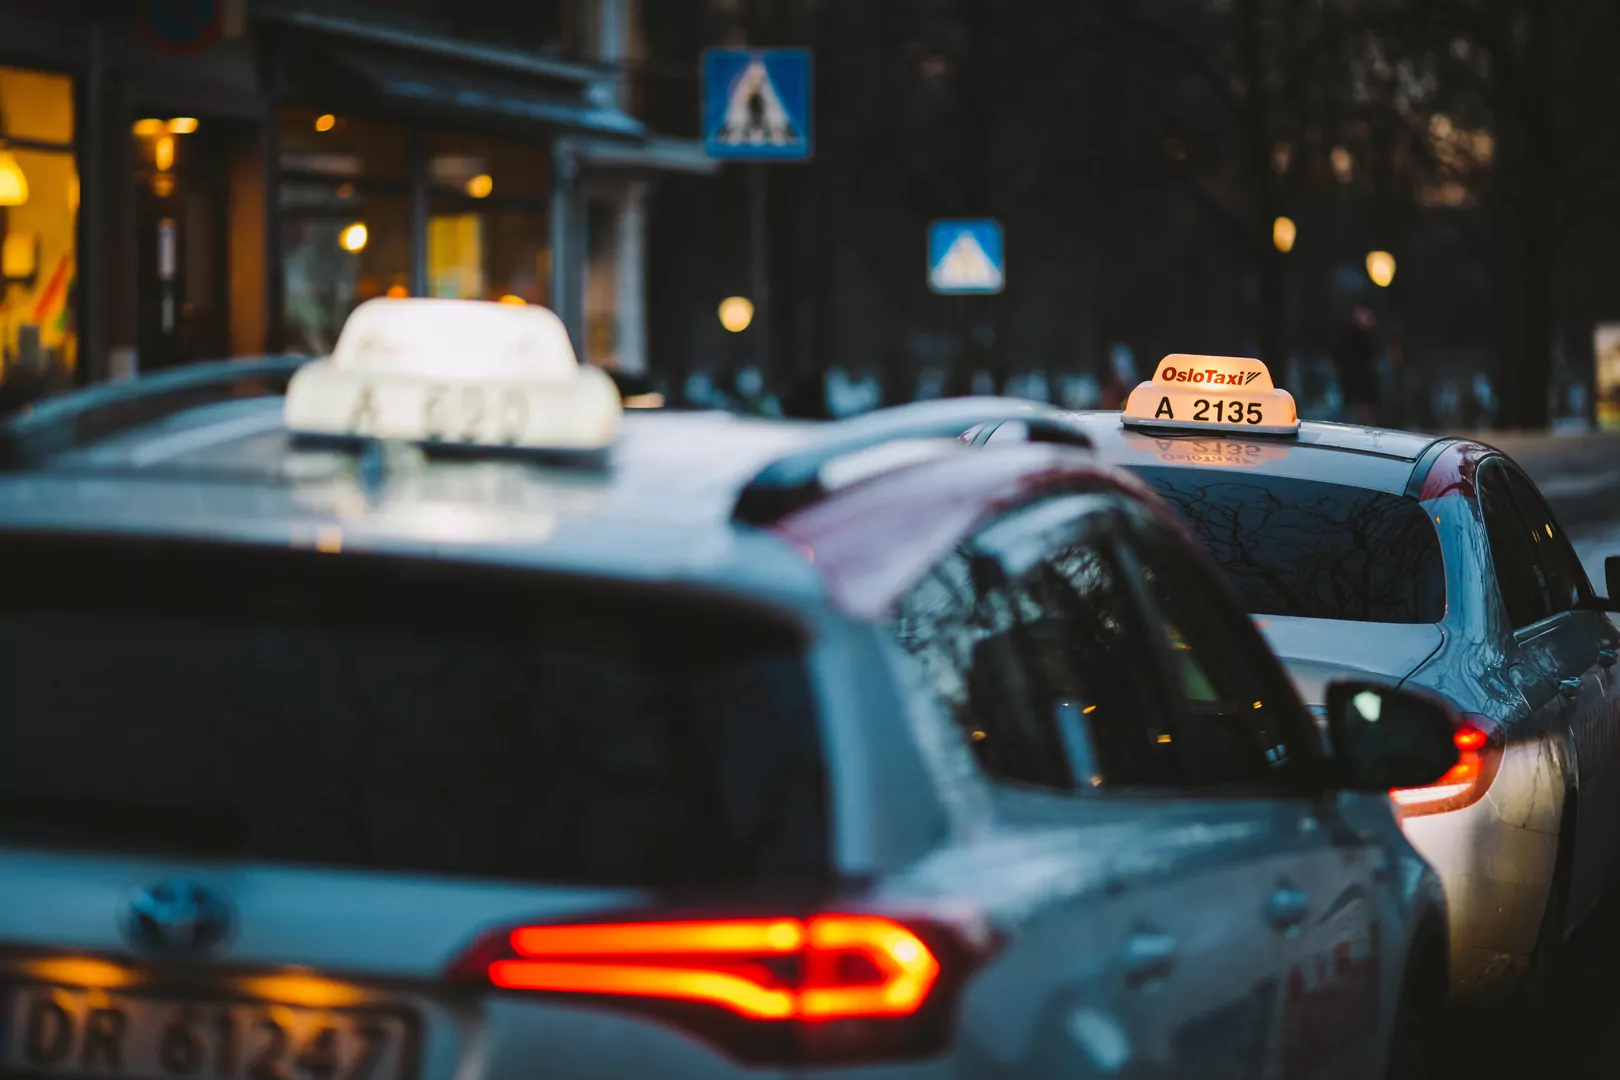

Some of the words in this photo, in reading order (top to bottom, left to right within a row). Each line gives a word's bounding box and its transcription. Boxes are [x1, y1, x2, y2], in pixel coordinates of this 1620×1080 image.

[1161, 367, 1245, 386] OsloTaxi
[1154, 396, 1174, 419] A
[1193, 399, 1263, 425] 2135
[25, 996, 128, 1072] DR
